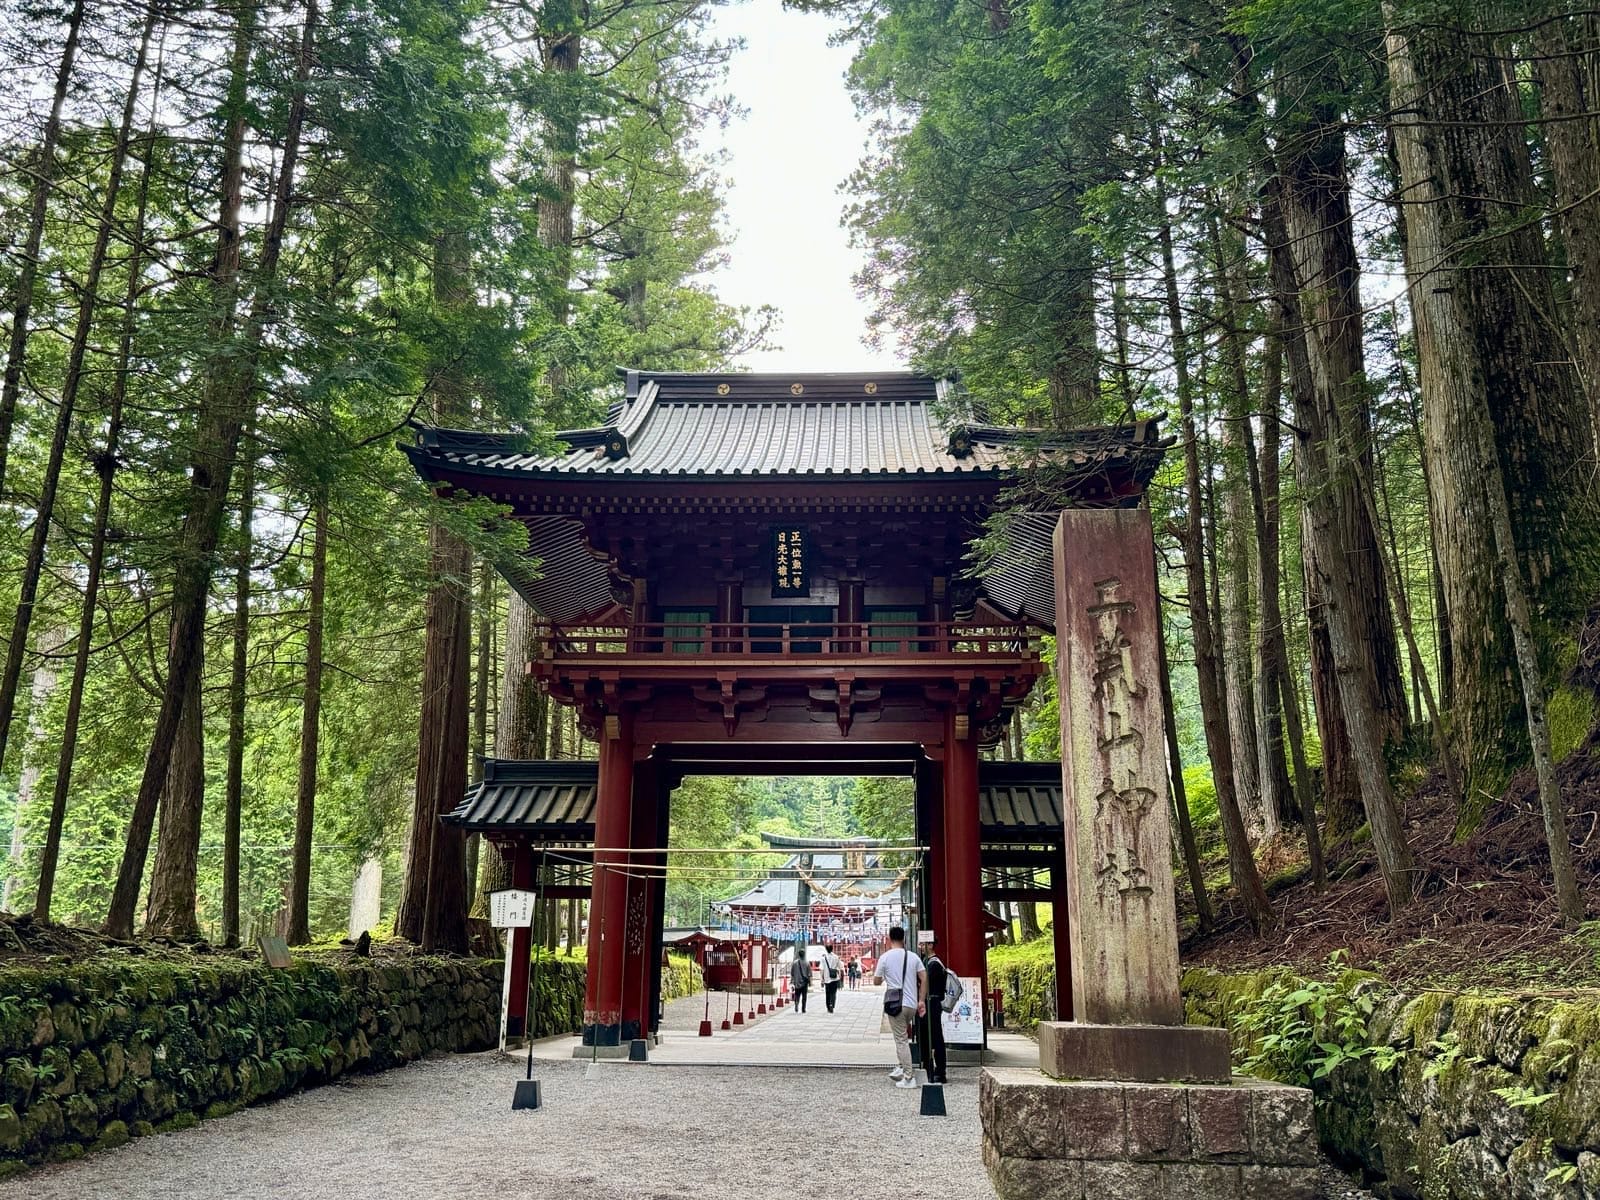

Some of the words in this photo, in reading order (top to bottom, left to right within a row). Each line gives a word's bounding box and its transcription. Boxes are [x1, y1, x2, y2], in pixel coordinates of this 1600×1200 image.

[1086, 576, 1157, 900] 二荒山神社
